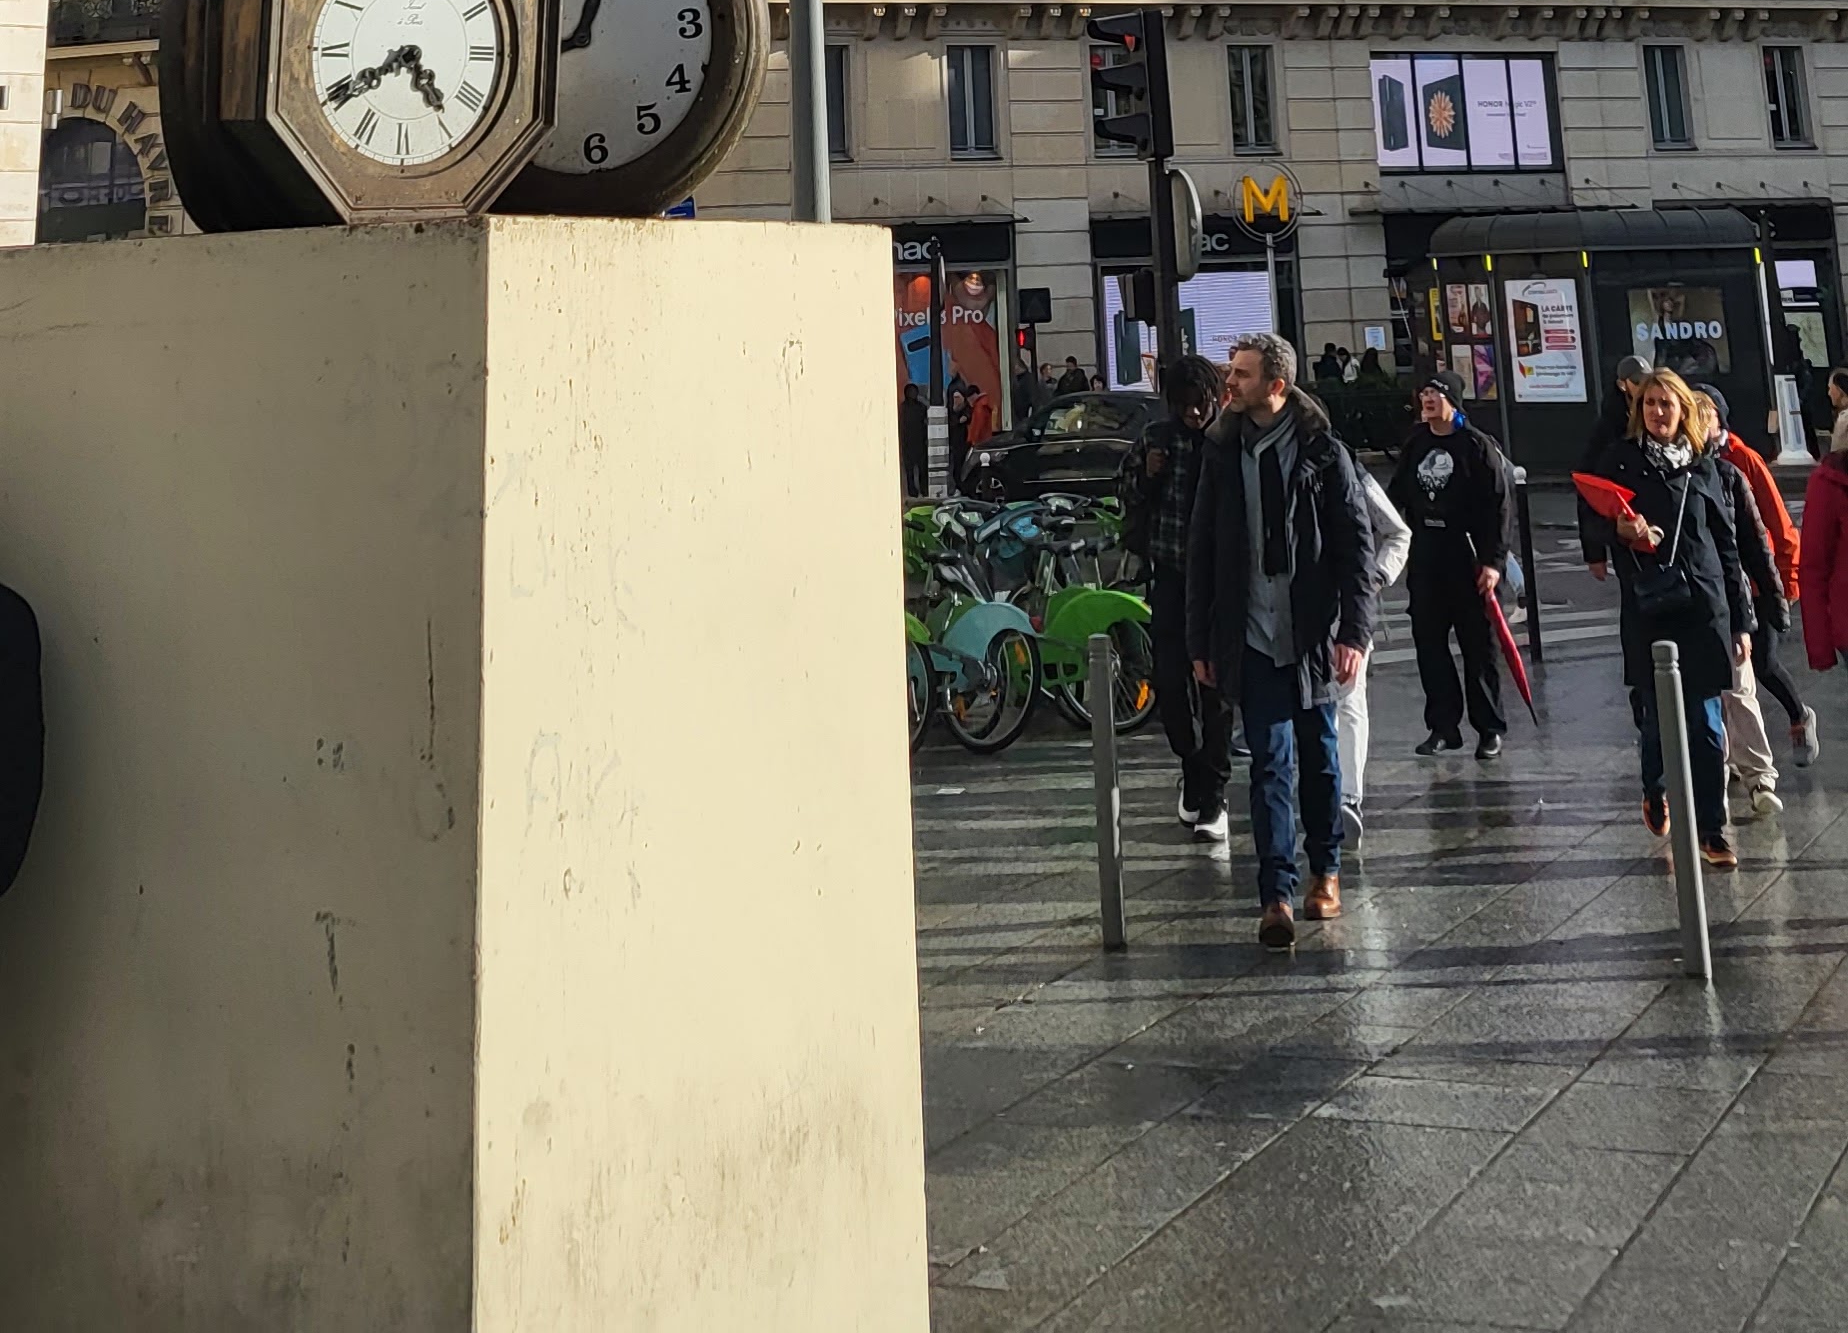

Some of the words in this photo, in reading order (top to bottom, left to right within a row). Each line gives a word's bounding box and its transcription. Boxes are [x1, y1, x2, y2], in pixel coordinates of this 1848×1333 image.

[677, 8, 702, 39] 3
[665, 63, 692, 93] 4
[71, 83, 117, 114] DU
[636, 102, 661, 135] 5
[584, 133, 608, 164] 6
[1242, 175, 1289, 223] M
[893, 241, 932, 261] nac
[896, 307, 931, 327] ixel
[952, 305, 984, 325] Pro
[1636, 321, 1723, 340] SANDRO
